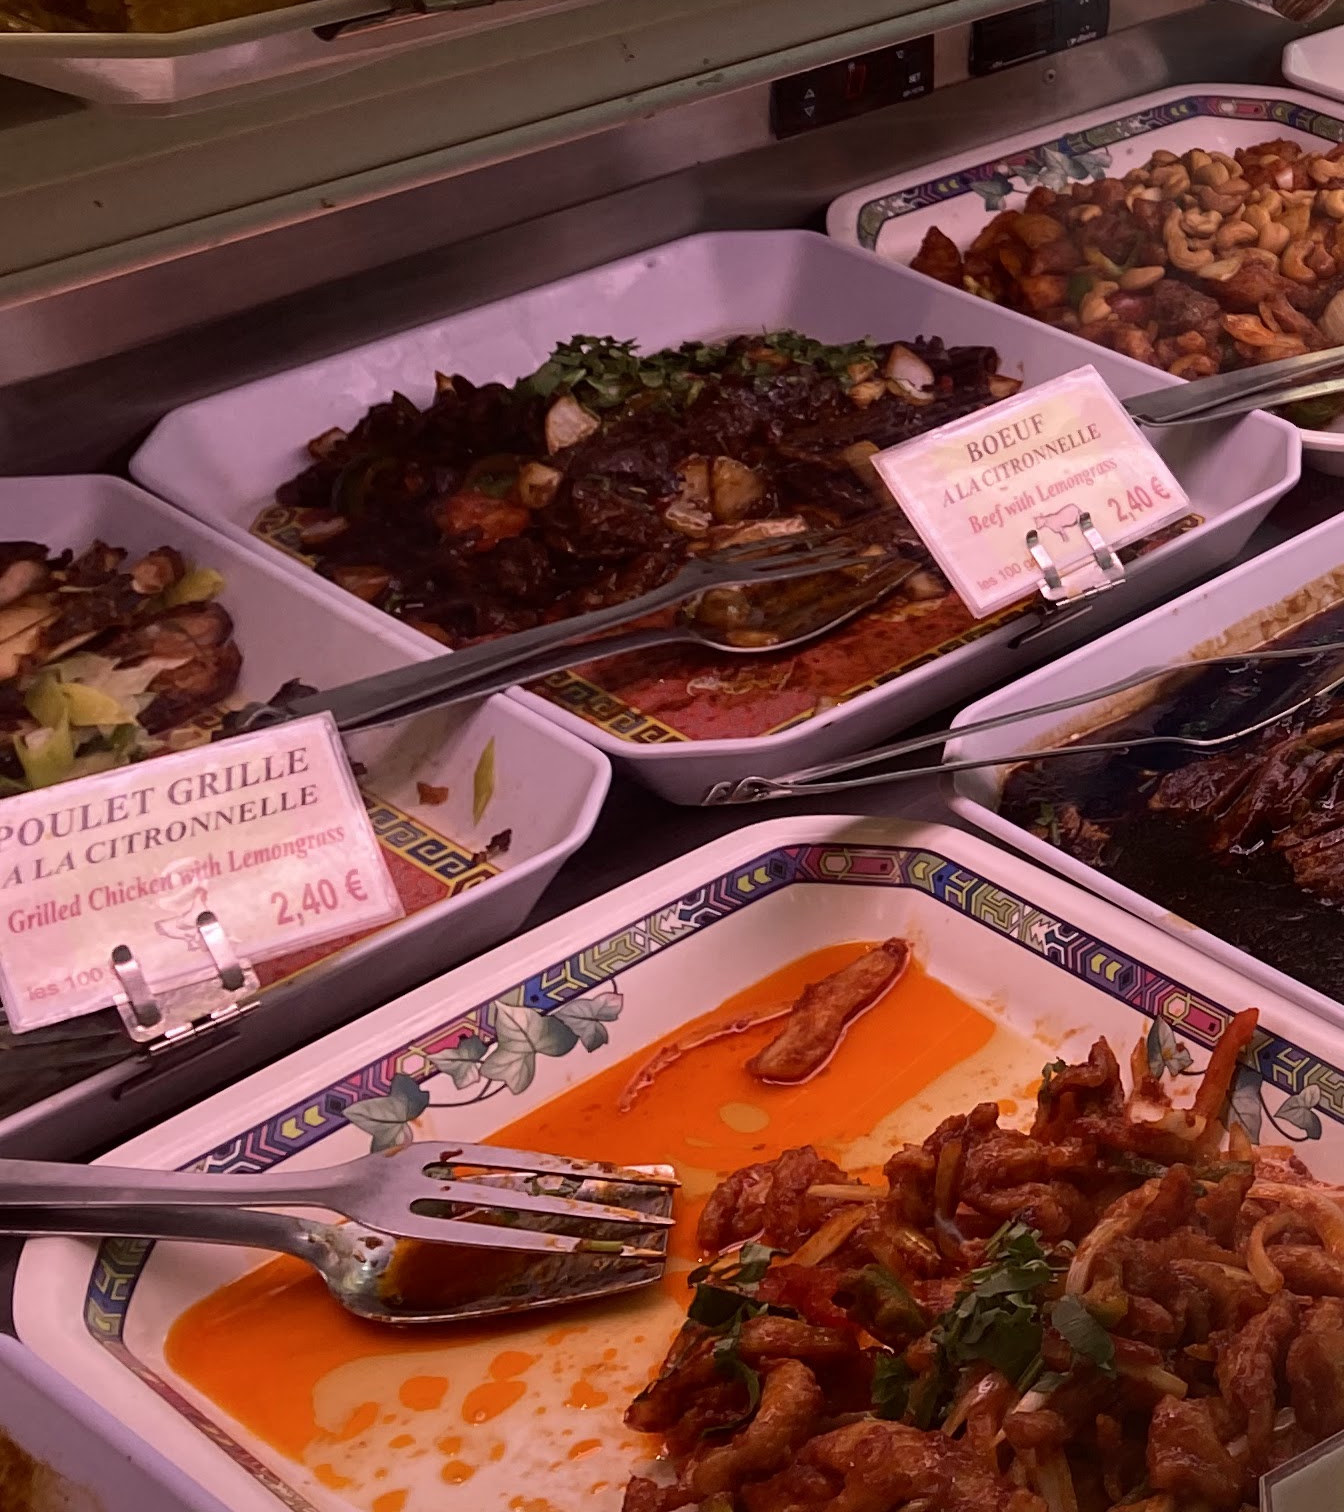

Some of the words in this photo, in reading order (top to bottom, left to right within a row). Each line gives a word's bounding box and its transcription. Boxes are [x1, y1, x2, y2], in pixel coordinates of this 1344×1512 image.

[966, 413, 1044, 464] BOEUF
[982, 422, 1102, 488] CITRONNELLE
[967, 506, 1006, 535] Beef
[1005, 494, 1036, 518] with
[1035, 457, 1119, 503] Lemongrass
[1106, 485, 1154, 523] 2,40
[1150, 476, 1170, 500] €
[999, 562, 1022, 579] 100
[0, 787, 155, 852] POULET
[167, 747, 311, 806] GRILLE
[2, 864, 24, 888] A
[32, 852, 76, 882] LA
[86, 784, 319, 865] CITRONNELLE
[7, 894, 82, 936] Grilled
[88, 874, 174, 912] Chicken
[180, 852, 221, 882] with
[226, 824, 346, 874] Lemongrass
[270, 878, 338, 926] 2,40
[344, 868, 368, 902] €
[63, 968, 104, 992] 100
